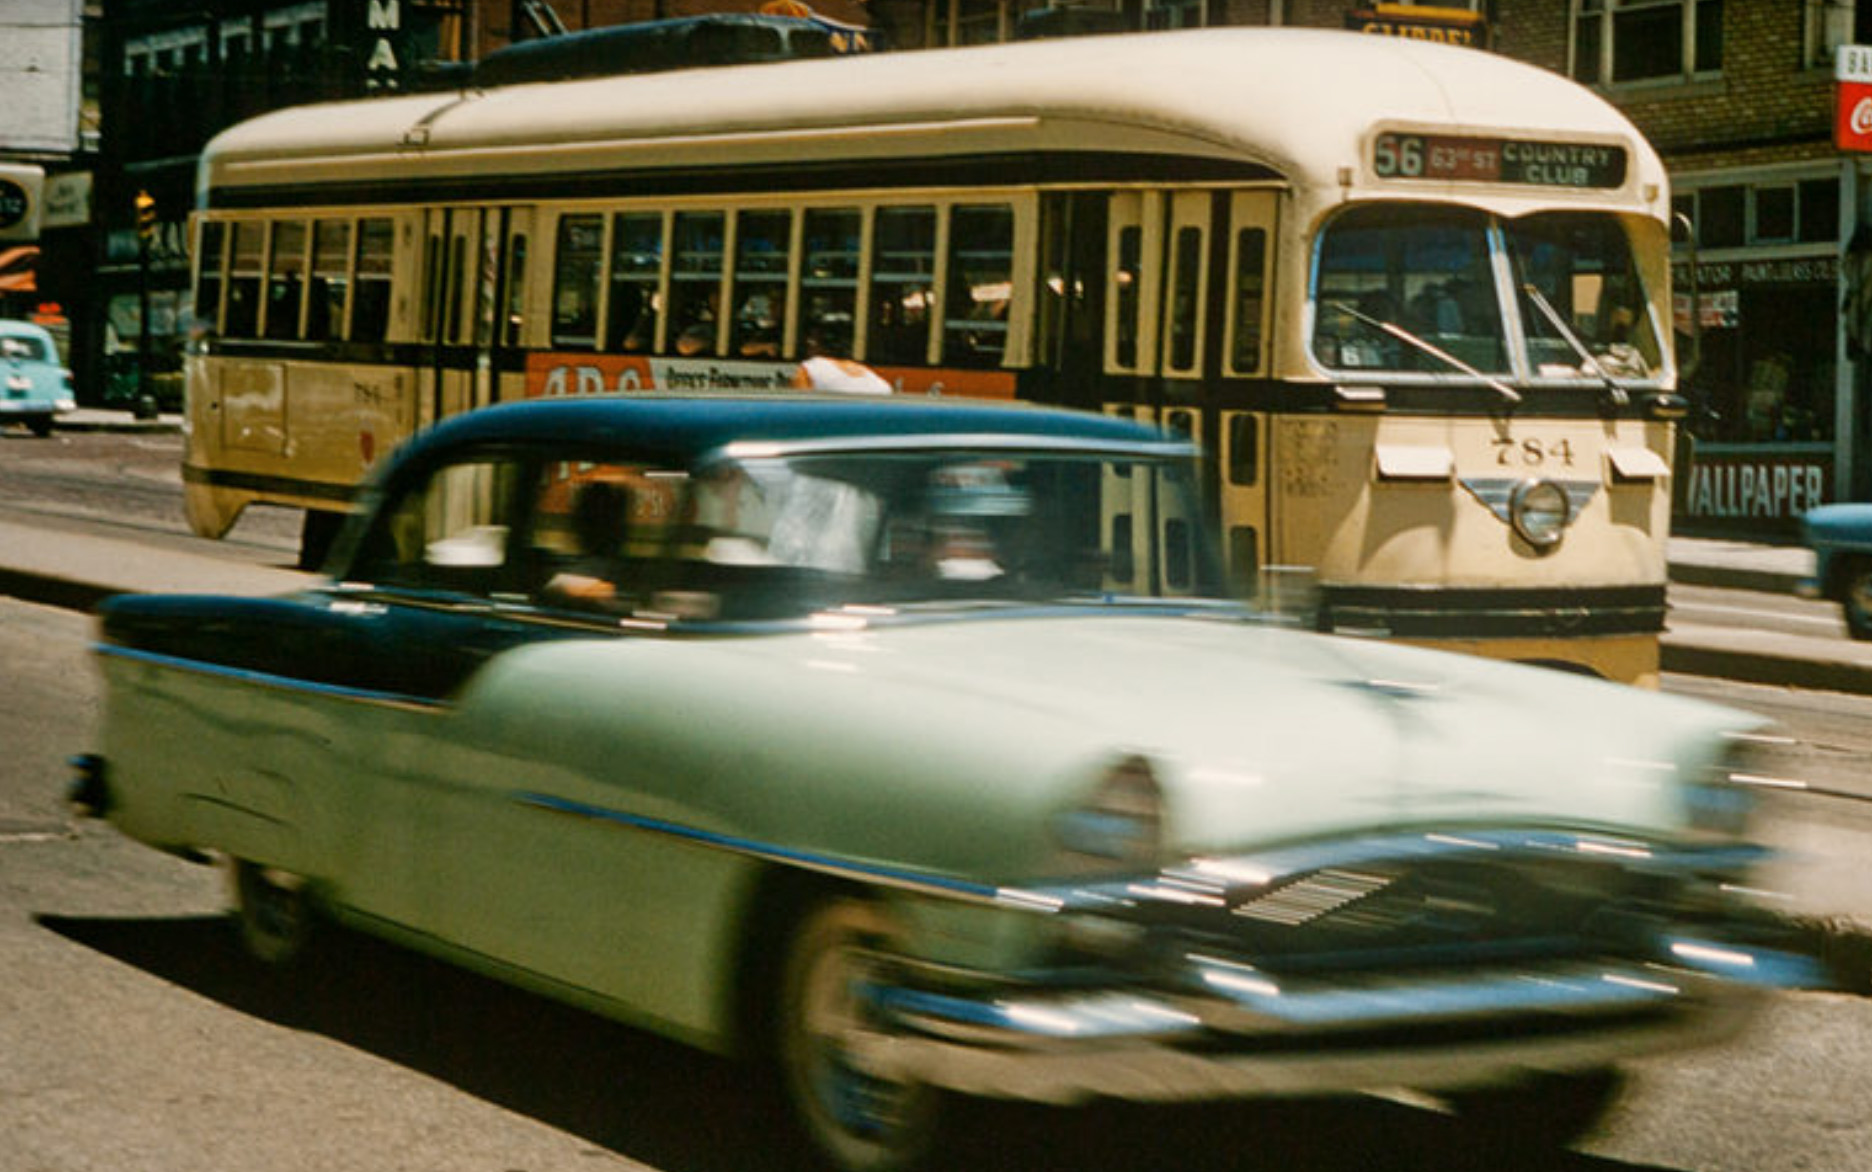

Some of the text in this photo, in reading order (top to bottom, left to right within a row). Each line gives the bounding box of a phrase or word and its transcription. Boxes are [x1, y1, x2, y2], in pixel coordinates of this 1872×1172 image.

[1376, 136, 1422, 175] 56
[1503, 143, 1610, 166] COUNTRY
[1526, 165, 1588, 185] CLUB
[1491, 437, 1575, 466] 784
